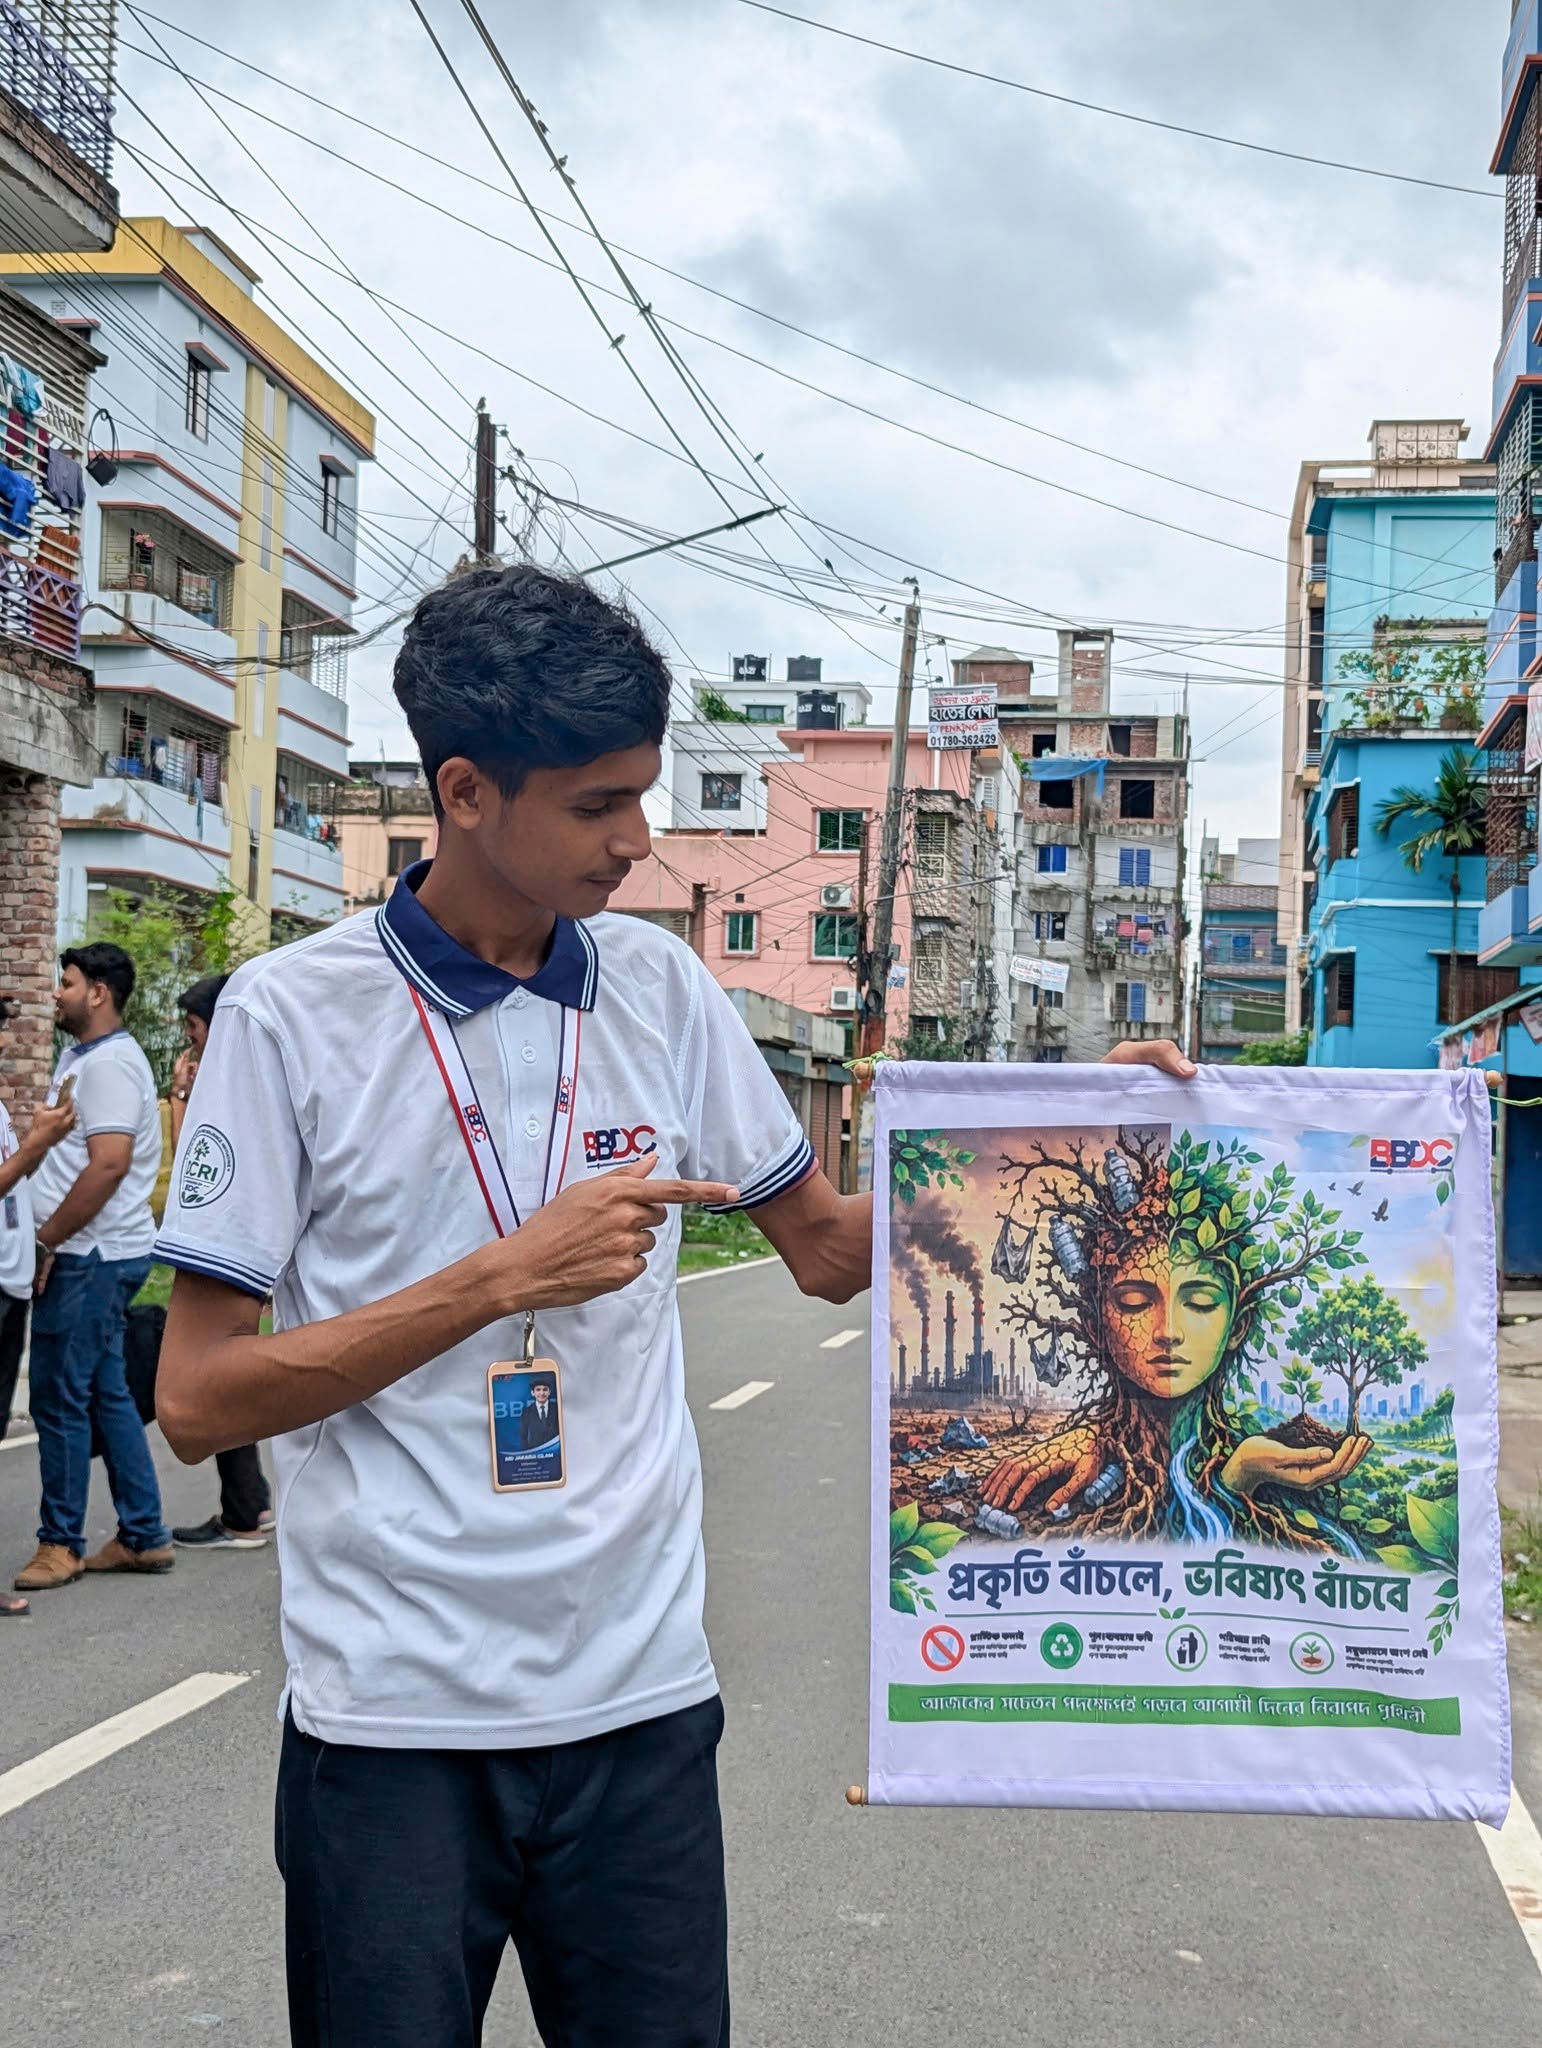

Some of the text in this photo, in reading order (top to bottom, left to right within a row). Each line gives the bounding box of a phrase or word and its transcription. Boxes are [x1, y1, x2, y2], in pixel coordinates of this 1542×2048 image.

[929, 703, 997, 722] হাতের লেখা
[960, 696, 969, 704] ও
[930, 733, 997, 747] 01780-362429
[582, 1125, 657, 1163] BBDC
[1370, 1138, 1453, 1168] BBDC
[947, 1545, 1411, 1613] প্রকৃতি বাঁচলে, ভবিষ্যৎ বাঁচবে
[920, 1695, 994, 1713] আজকের
[1000, 1695, 1056, 1712] সচেতন
[1062, 1693, 1137, 1713] পদক্ষেপই
[1192, 1693, 1252, 1714] আগামী
[1258, 1695, 1305, 1716] দিনের
[1310, 1696, 1370, 1717] নিরাপদ
[1377, 1702, 1426, 1725] পৃথিবী
